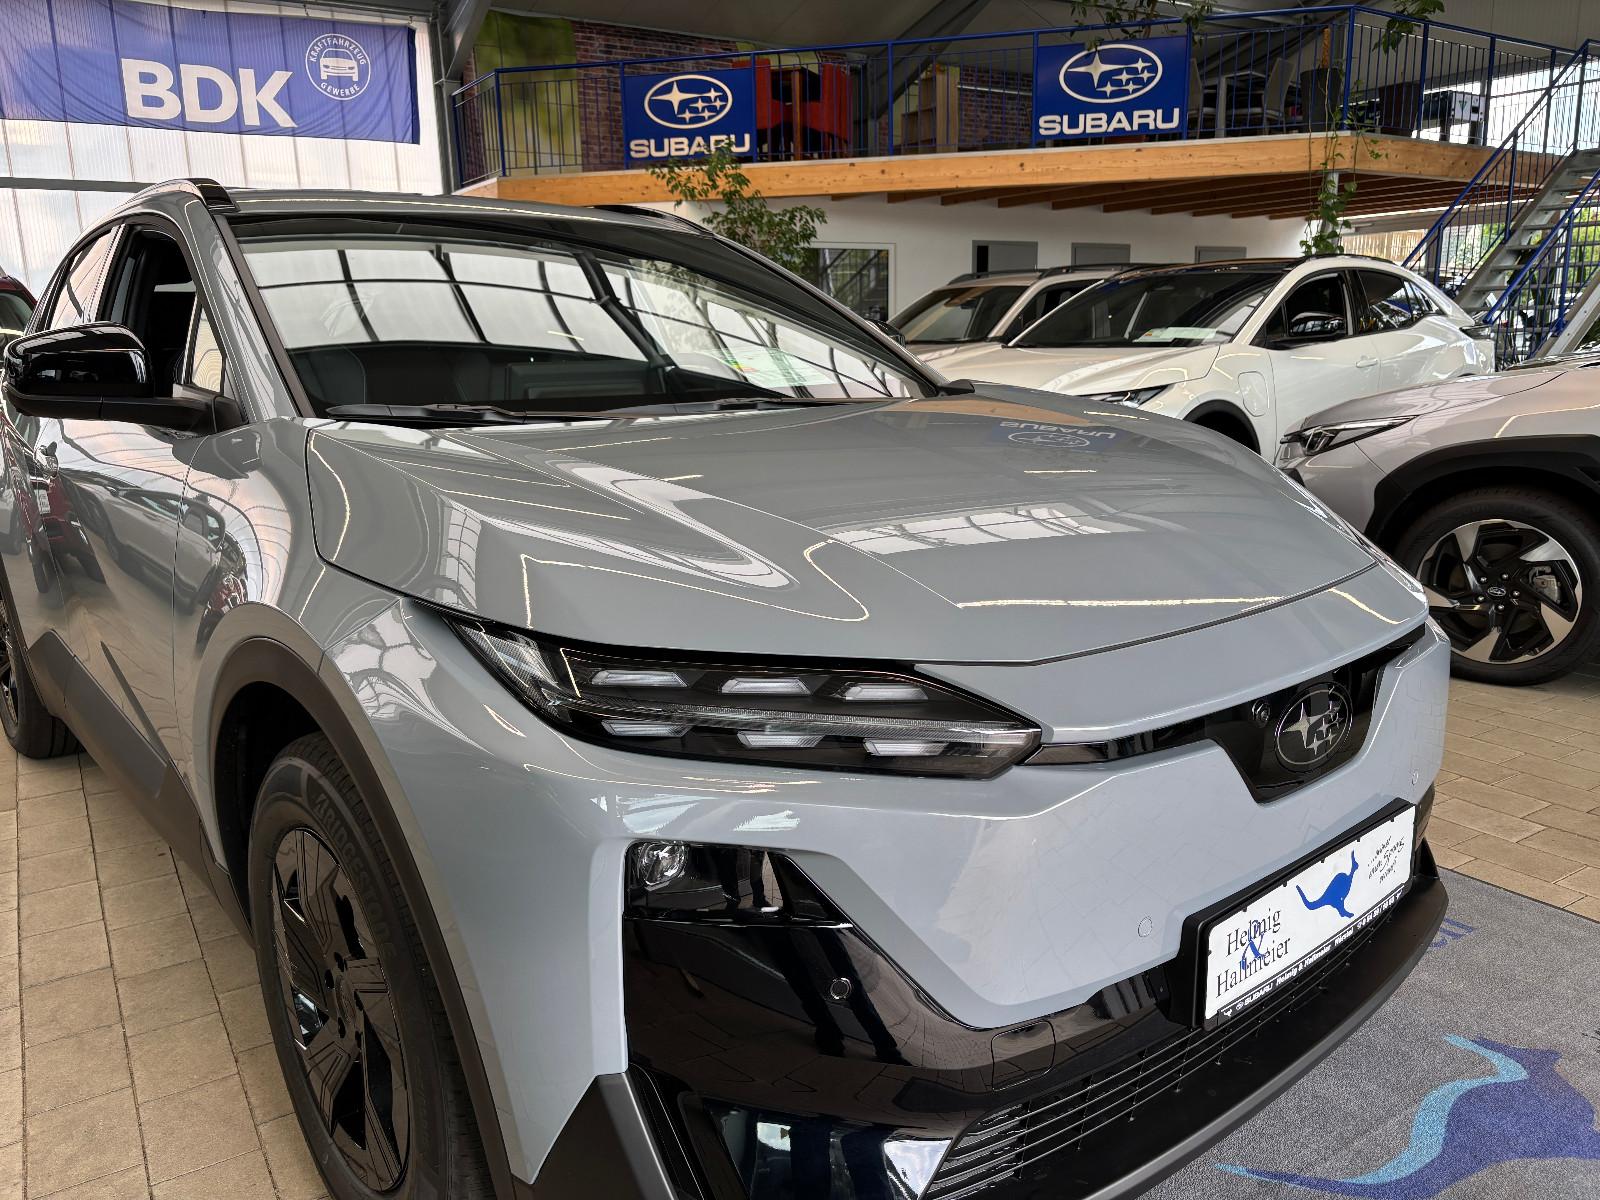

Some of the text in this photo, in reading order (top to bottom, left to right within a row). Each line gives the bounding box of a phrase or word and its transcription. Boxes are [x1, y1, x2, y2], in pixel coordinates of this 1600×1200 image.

[309, 37, 367, 65] KRAFTFAHRZEUG
[121, 58, 298, 128] BDK
[320, 82, 360, 97] GEWERBE
[1038, 107, 1181, 136] SUBARU
[629, 133, 751, 159] SUBARU
[1225, 907, 1281, 957] Helmig
[1216, 936, 1291, 998] Hallmeier
[1244, 982, 1273, 1006] SUBARU
